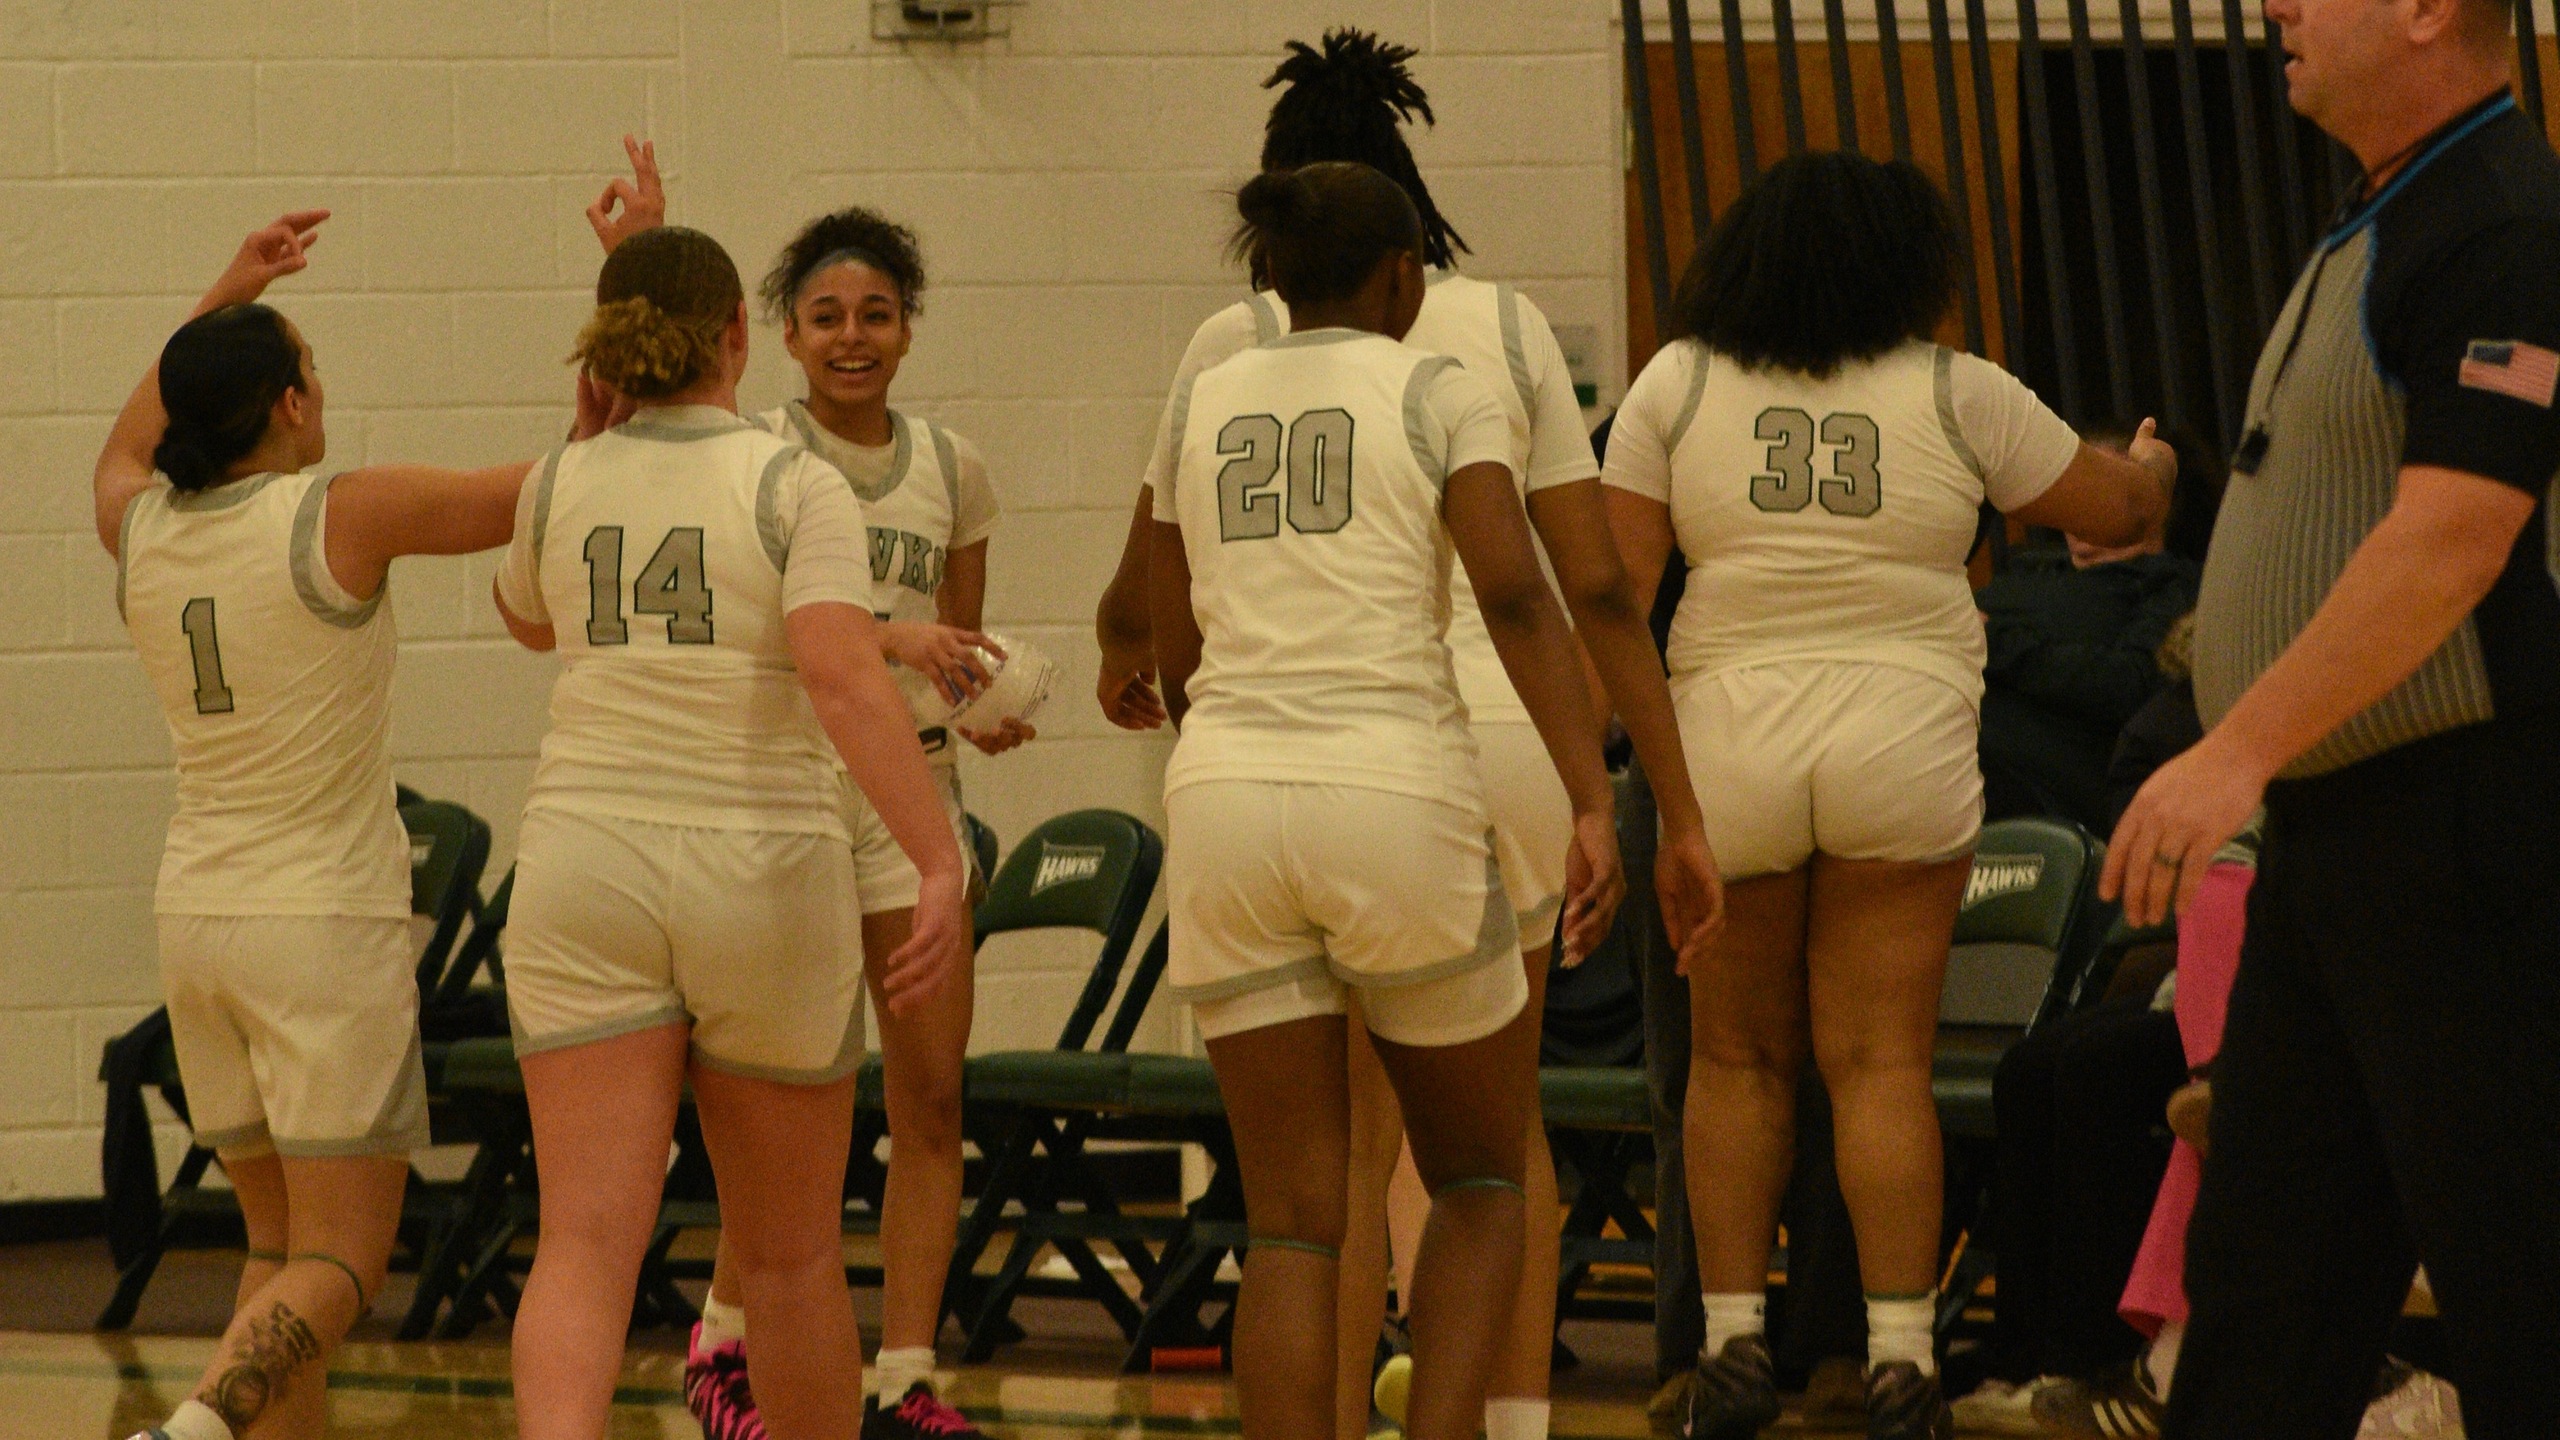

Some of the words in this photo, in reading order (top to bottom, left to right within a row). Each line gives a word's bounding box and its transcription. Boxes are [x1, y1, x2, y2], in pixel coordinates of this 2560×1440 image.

[1216, 407, 1354, 544] 20
[1749, 406, 1882, 519] 33
[583, 526, 714, 645] 14
[182, 597, 235, 714] 1
[1036, 855, 1099, 888] HAWKS
[1966, 865, 2038, 904] HAWKS
